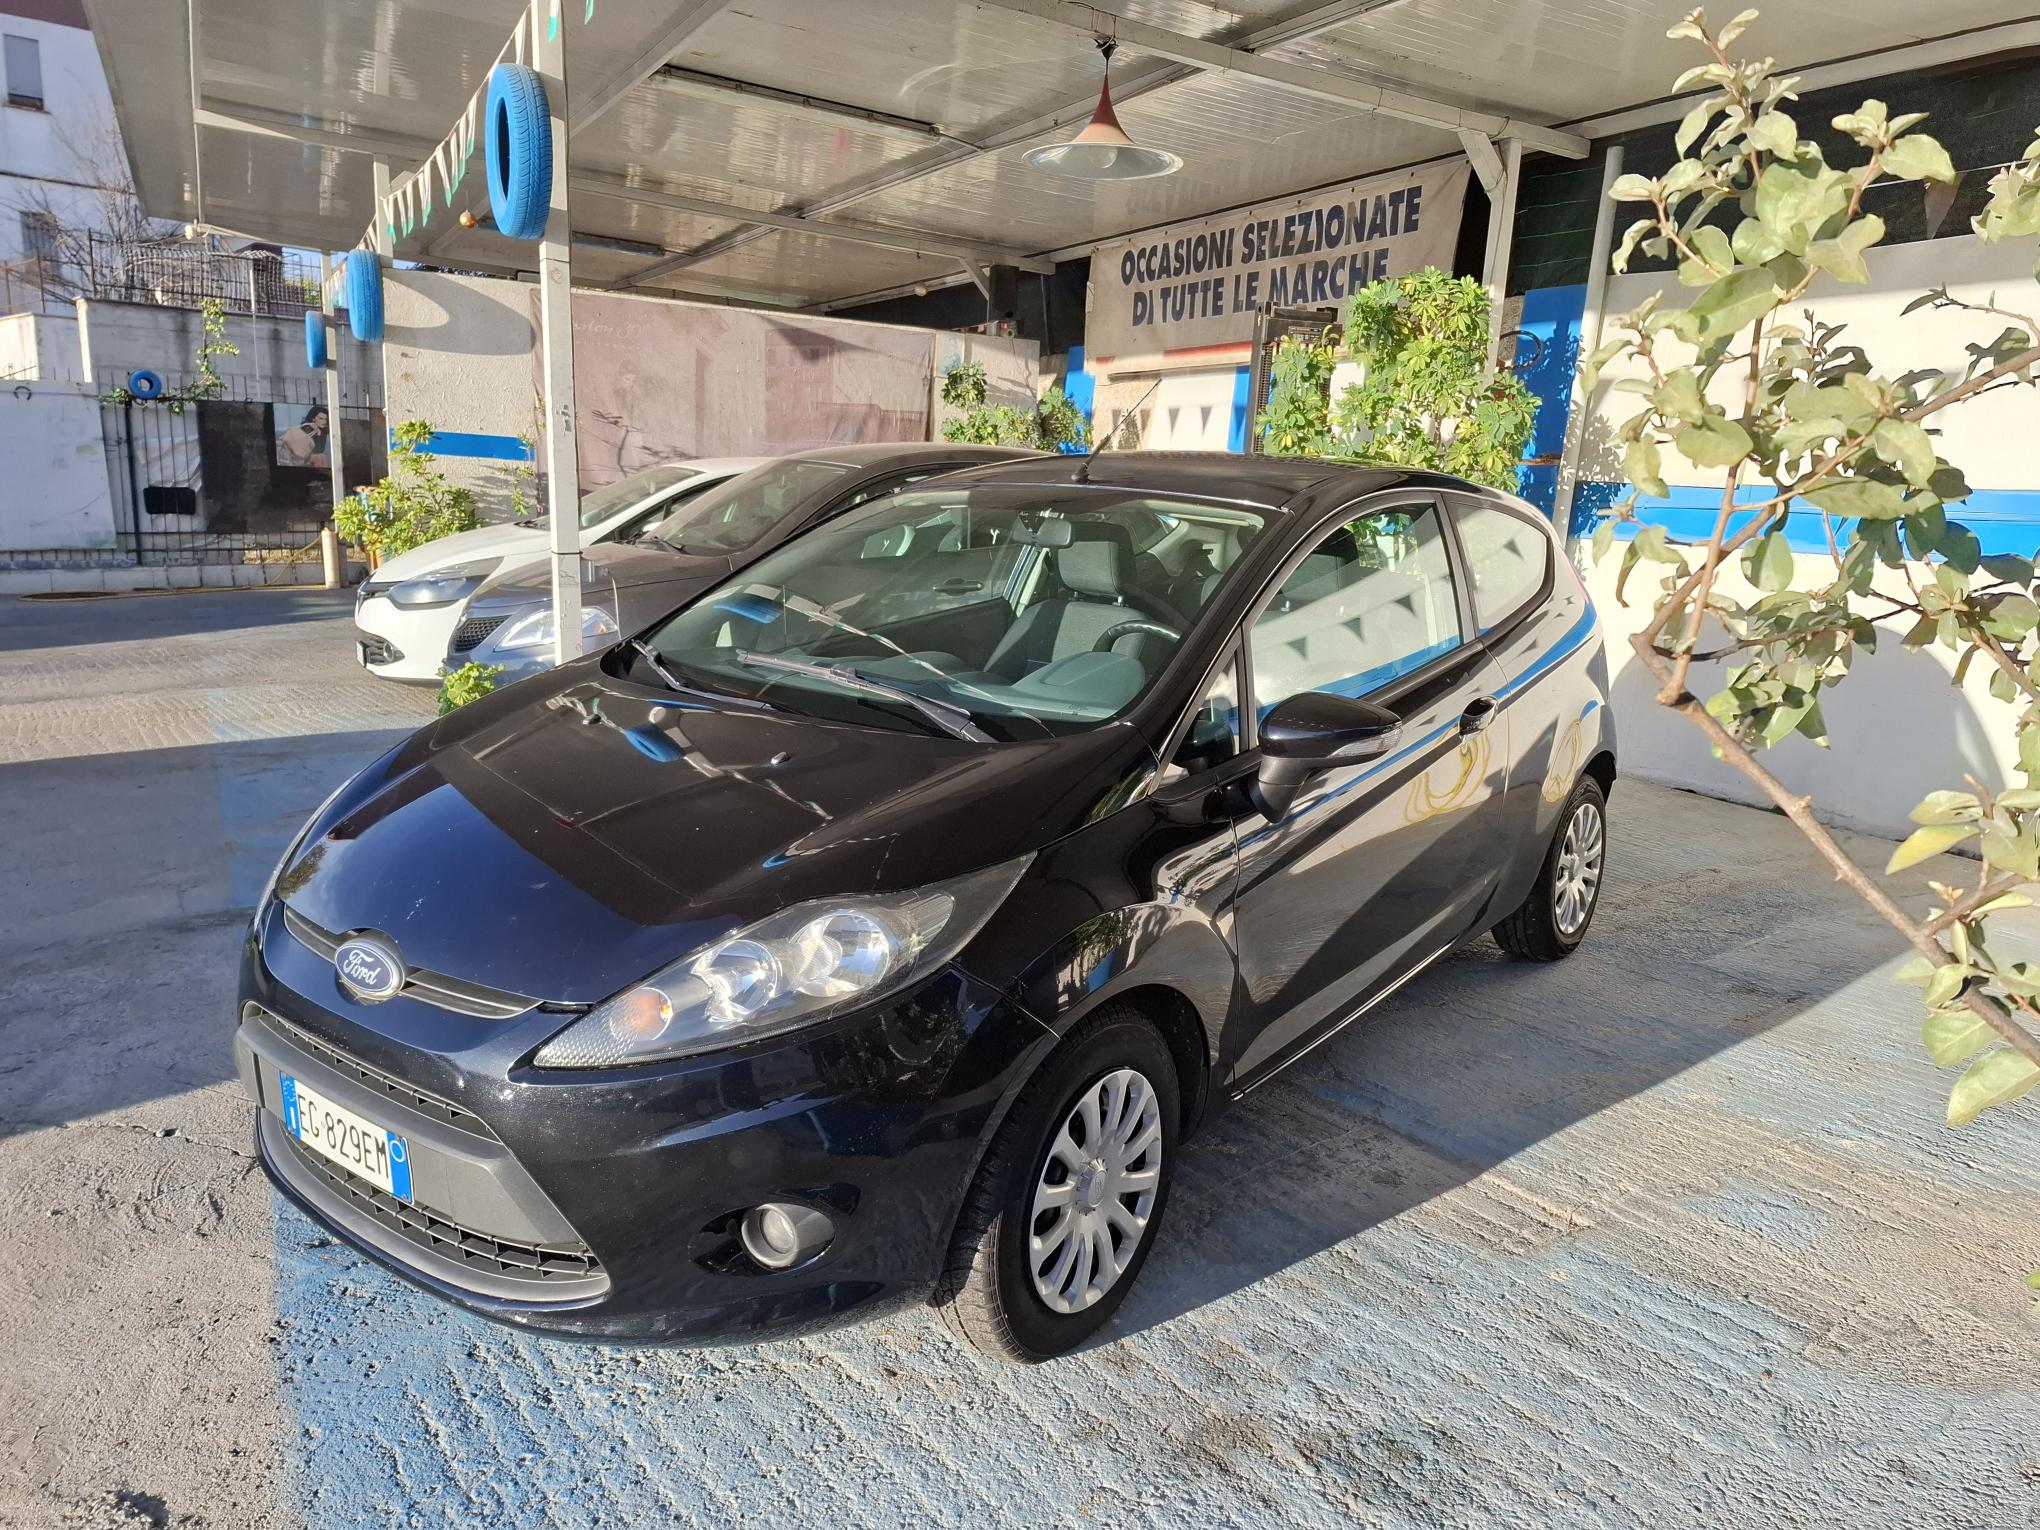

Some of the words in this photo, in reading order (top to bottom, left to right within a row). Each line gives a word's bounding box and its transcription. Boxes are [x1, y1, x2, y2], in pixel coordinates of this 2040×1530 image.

[1121, 228, 1235, 286] OCCASIONI
[1241, 185, 1422, 264] SELEZIONATE
[1132, 289, 1154, 326] DI
[1160, 277, 1224, 323] TUTTE
[1232, 271, 1260, 313] LE
[1268, 248, 1389, 306] MARCHE
[343, 949, 377, 986] Ford
